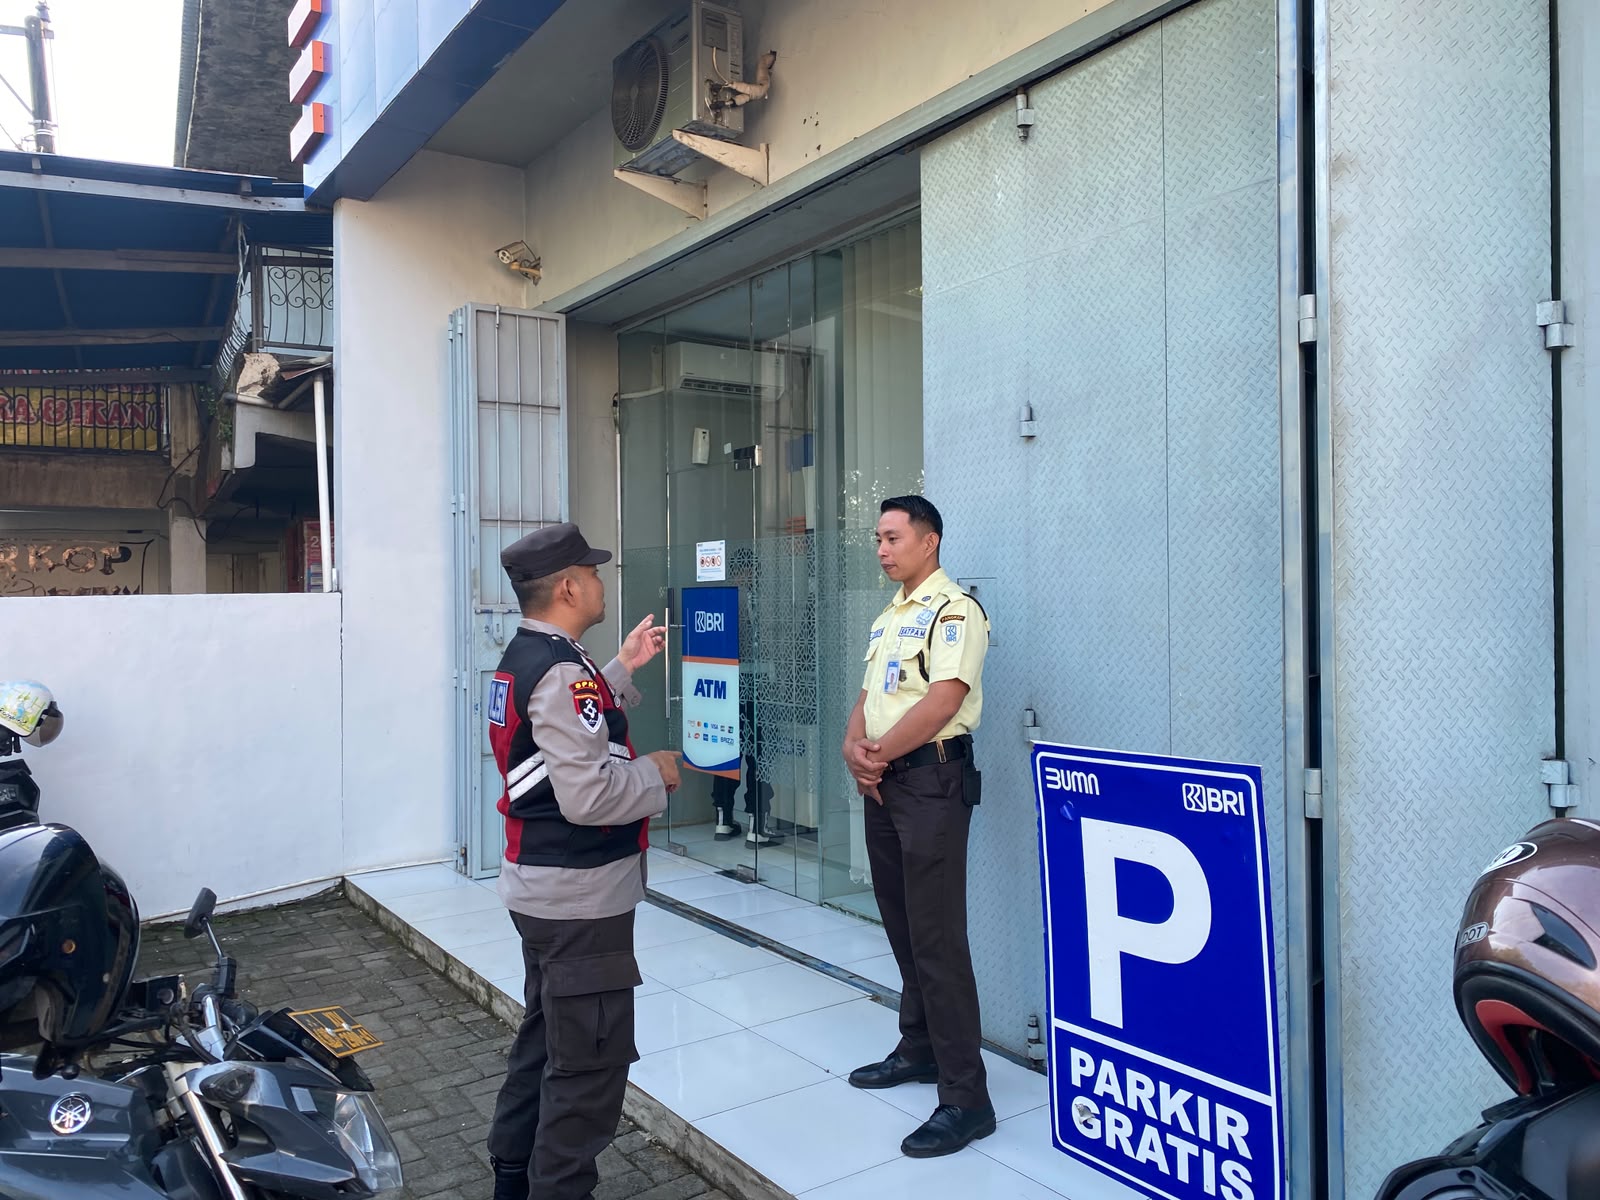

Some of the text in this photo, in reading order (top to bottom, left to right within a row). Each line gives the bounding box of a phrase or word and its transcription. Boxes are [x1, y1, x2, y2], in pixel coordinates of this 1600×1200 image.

[70, 400, 150, 428] IKAN
[706, 612, 725, 632] BRI
[694, 678, 727, 699] ATM
[1207, 787, 1246, 817] BRI
[1080, 816, 1212, 1030] P
[1462, 926, 1485, 944] DOT
[1070, 1046, 1253, 1161] PARKIR
[1071, 1095, 1255, 1200] GRATIS
